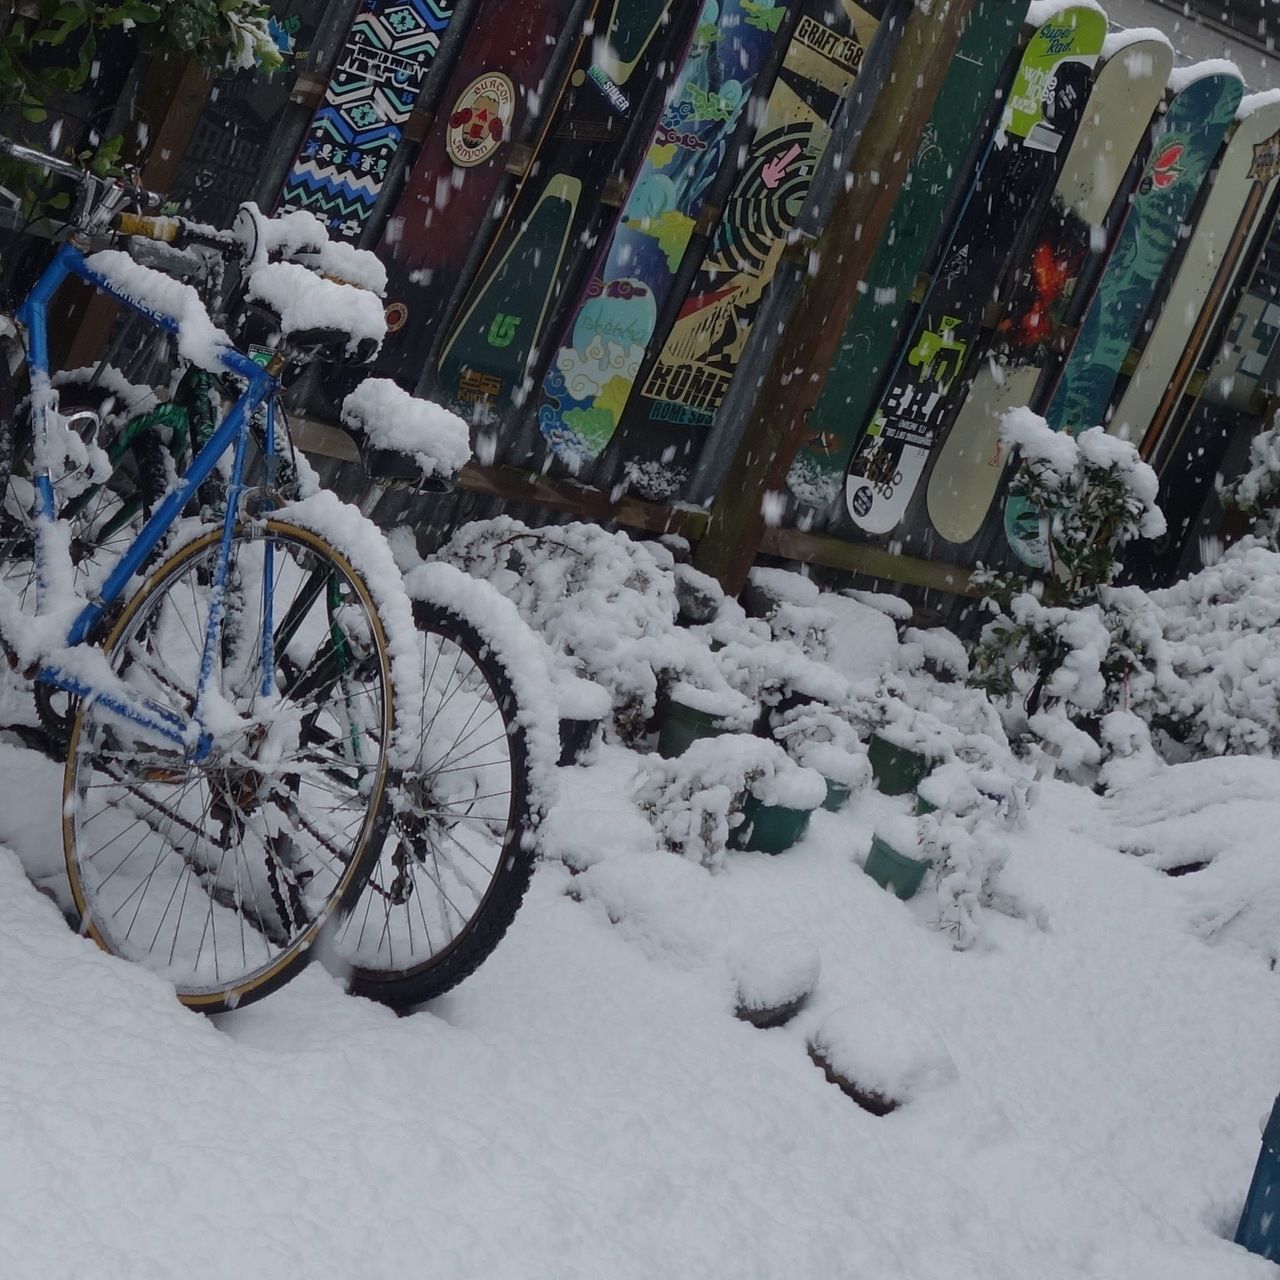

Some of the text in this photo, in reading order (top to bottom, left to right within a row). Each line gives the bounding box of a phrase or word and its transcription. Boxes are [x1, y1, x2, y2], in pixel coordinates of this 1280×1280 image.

[798, 18, 865, 67] GRAFT 158
[1039, 24, 1076, 41] Super
[474, 79, 510, 104] BURTON
